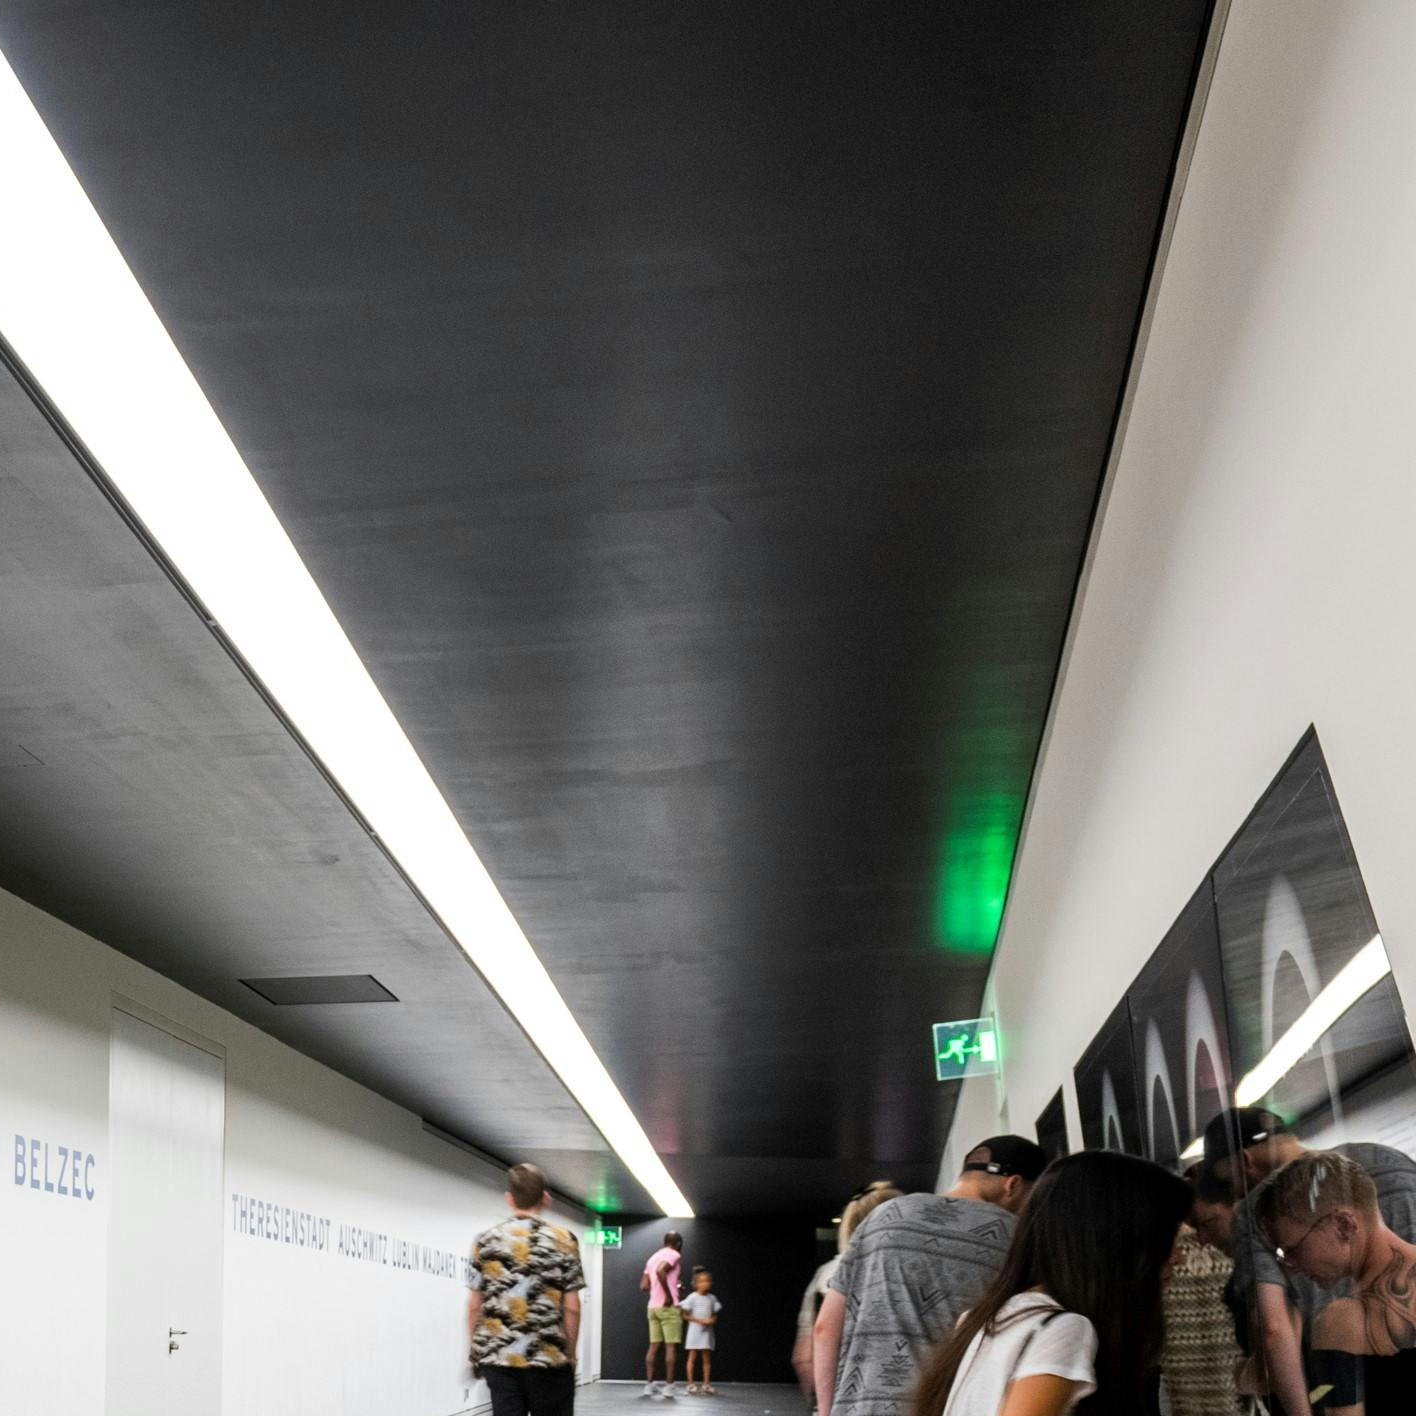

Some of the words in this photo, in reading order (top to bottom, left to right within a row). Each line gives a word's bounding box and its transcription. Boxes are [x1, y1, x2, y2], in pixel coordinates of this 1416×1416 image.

[14, 1134, 96, 1200] BELZEC
[232, 1193, 331, 1252] THERESIENSTADT
[338, 1223, 388, 1265] AUSCHWITZ
[392, 1238, 420, 1272] LUBLIN
